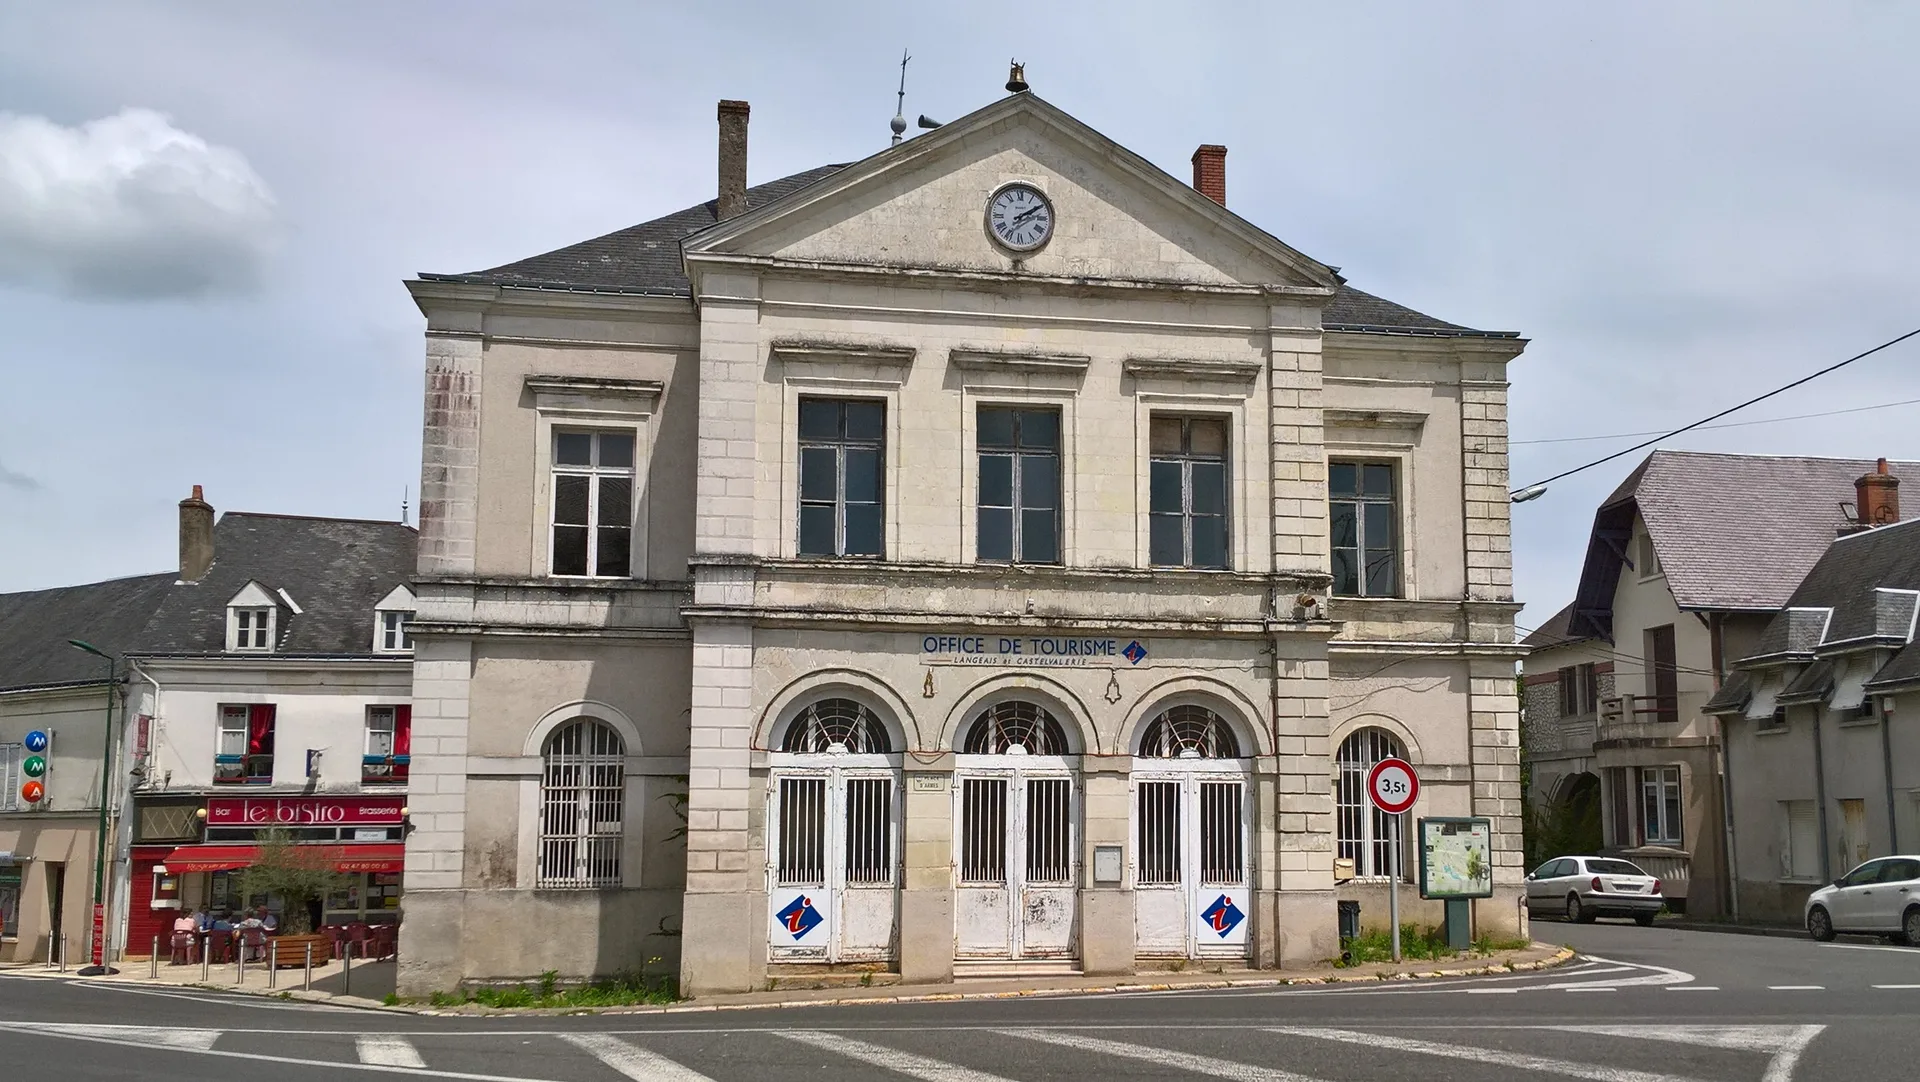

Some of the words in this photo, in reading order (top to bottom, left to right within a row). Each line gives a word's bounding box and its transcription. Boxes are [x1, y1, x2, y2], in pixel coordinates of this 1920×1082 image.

[924, 637, 984, 653] OFFICE
[999, 638, 1021, 654] DE
[1029, 639, 1116, 655] TOURISME
[954, 656, 997, 664] LANGEAIS
[1382, 778, 1406, 795] 3,5t
[215, 807, 231, 816] Bar
[243, 800, 266, 822] le
[359, 807, 398, 815] Brasserie
